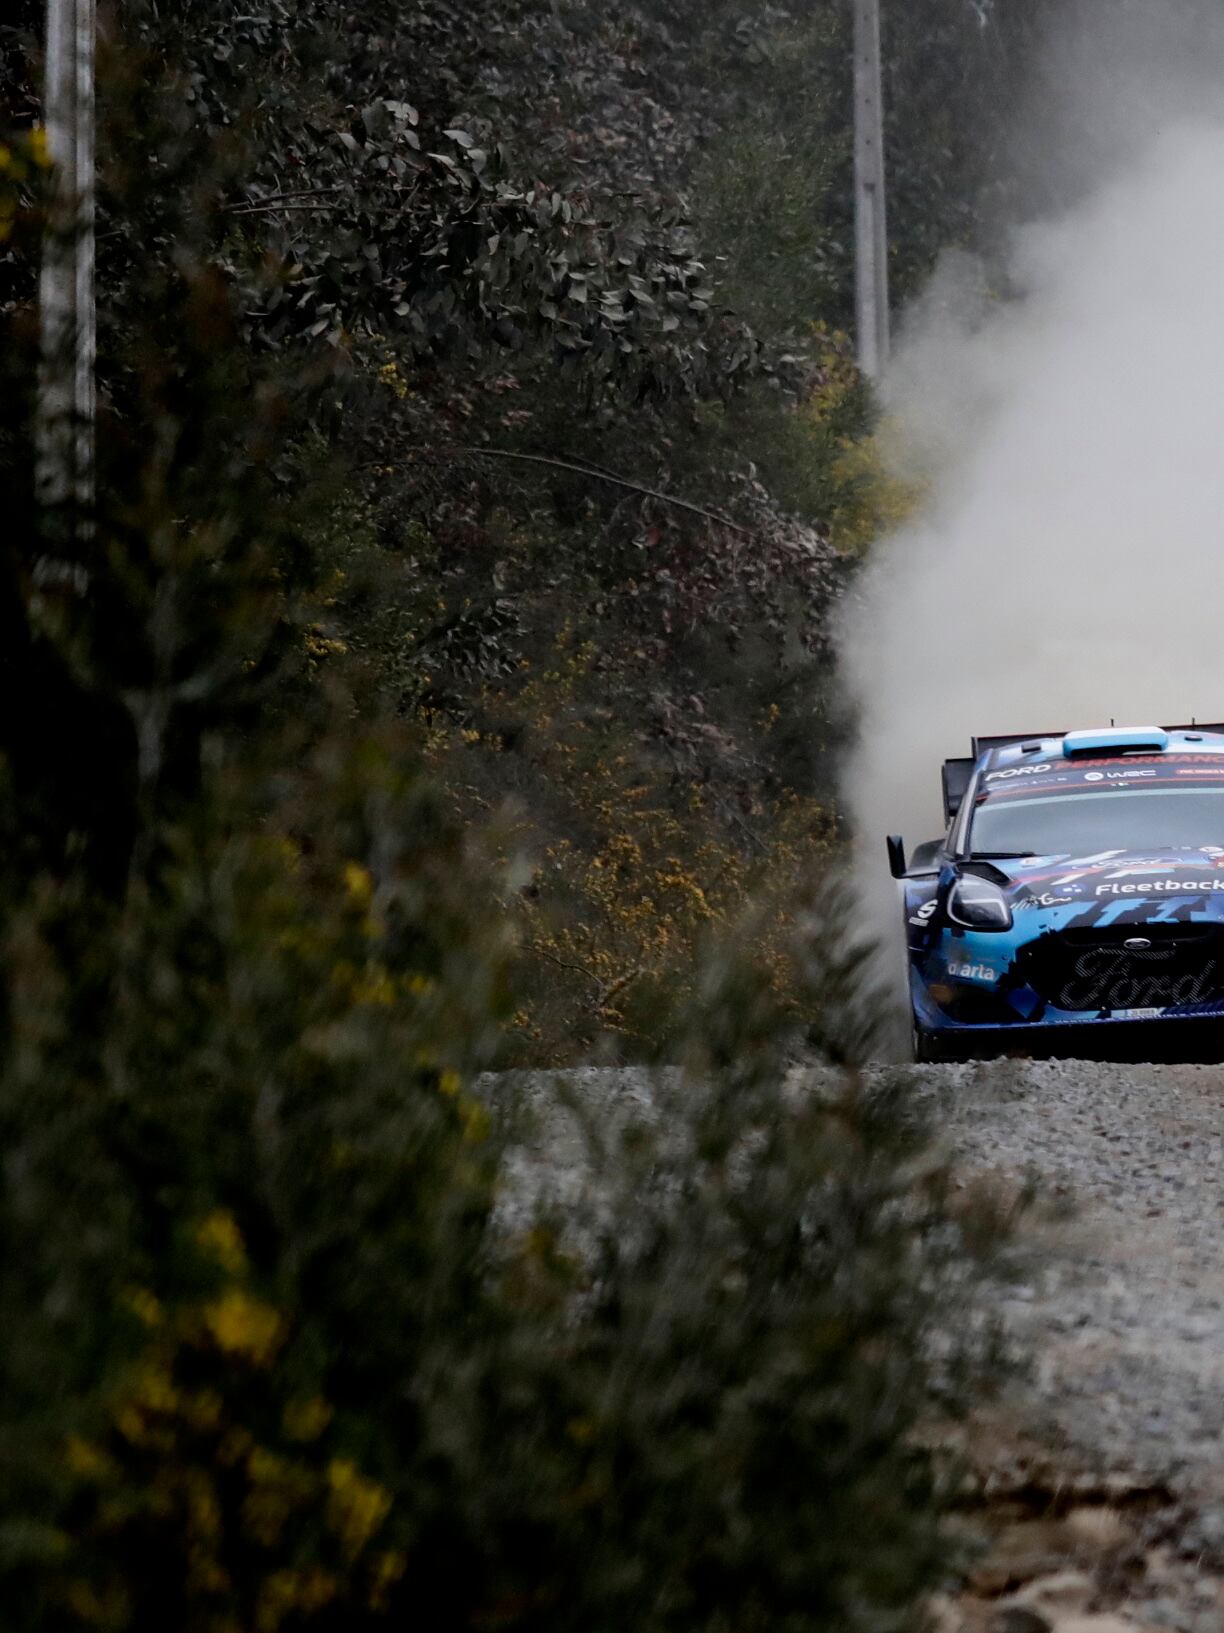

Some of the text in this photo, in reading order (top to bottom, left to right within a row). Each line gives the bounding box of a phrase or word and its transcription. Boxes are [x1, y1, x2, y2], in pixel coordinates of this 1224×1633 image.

[985, 765, 1051, 781] FORD
[1106, 770, 1156, 779] WRC
[1060, 948, 1217, 1009] Ford
